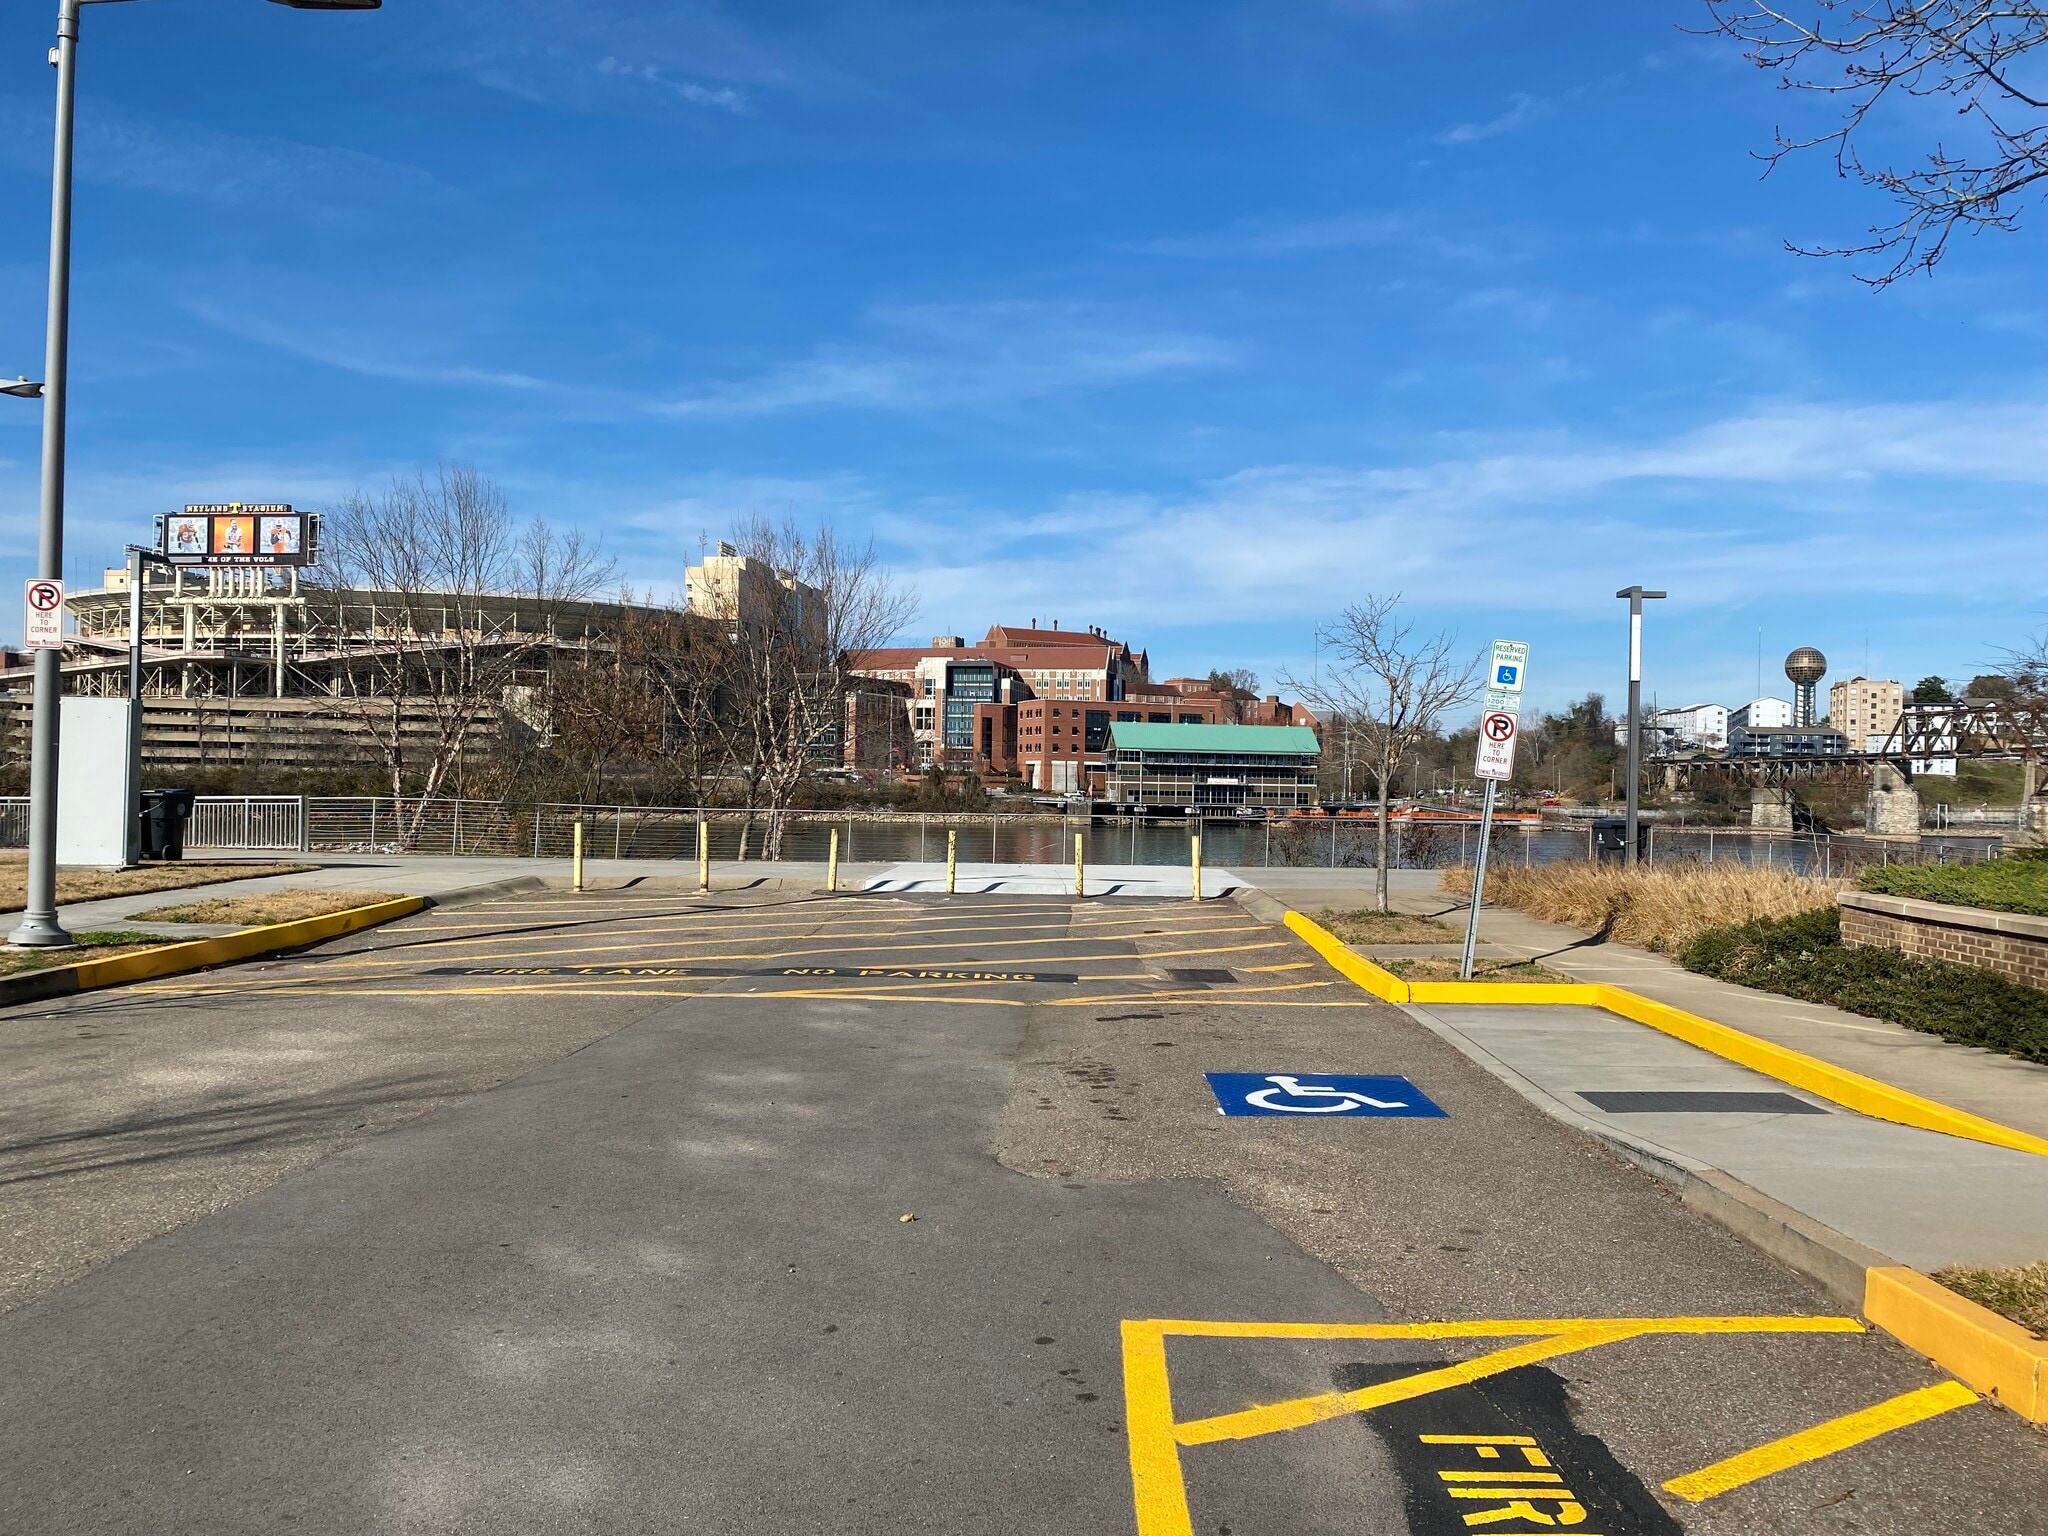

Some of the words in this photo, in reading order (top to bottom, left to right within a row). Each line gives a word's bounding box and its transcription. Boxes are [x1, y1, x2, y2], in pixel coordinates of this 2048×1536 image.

[186, 504, 228, 512] NEYLAND
[242, 504, 283, 512] STADIUM
[1495, 644, 1526, 655] RESERVED
[1495, 653, 1523, 663] PARKING
[1488, 741, 1506, 750] HERE
[1492, 749, 1501, 757] TO
[1482, 755, 1508, 765] CORNER
[464, 967, 560, 975] FIRE
[576, 968, 692, 976] LANE
[859, 969, 1036, 980] PARKING
[1418, 1434, 1605, 1536] FIR
